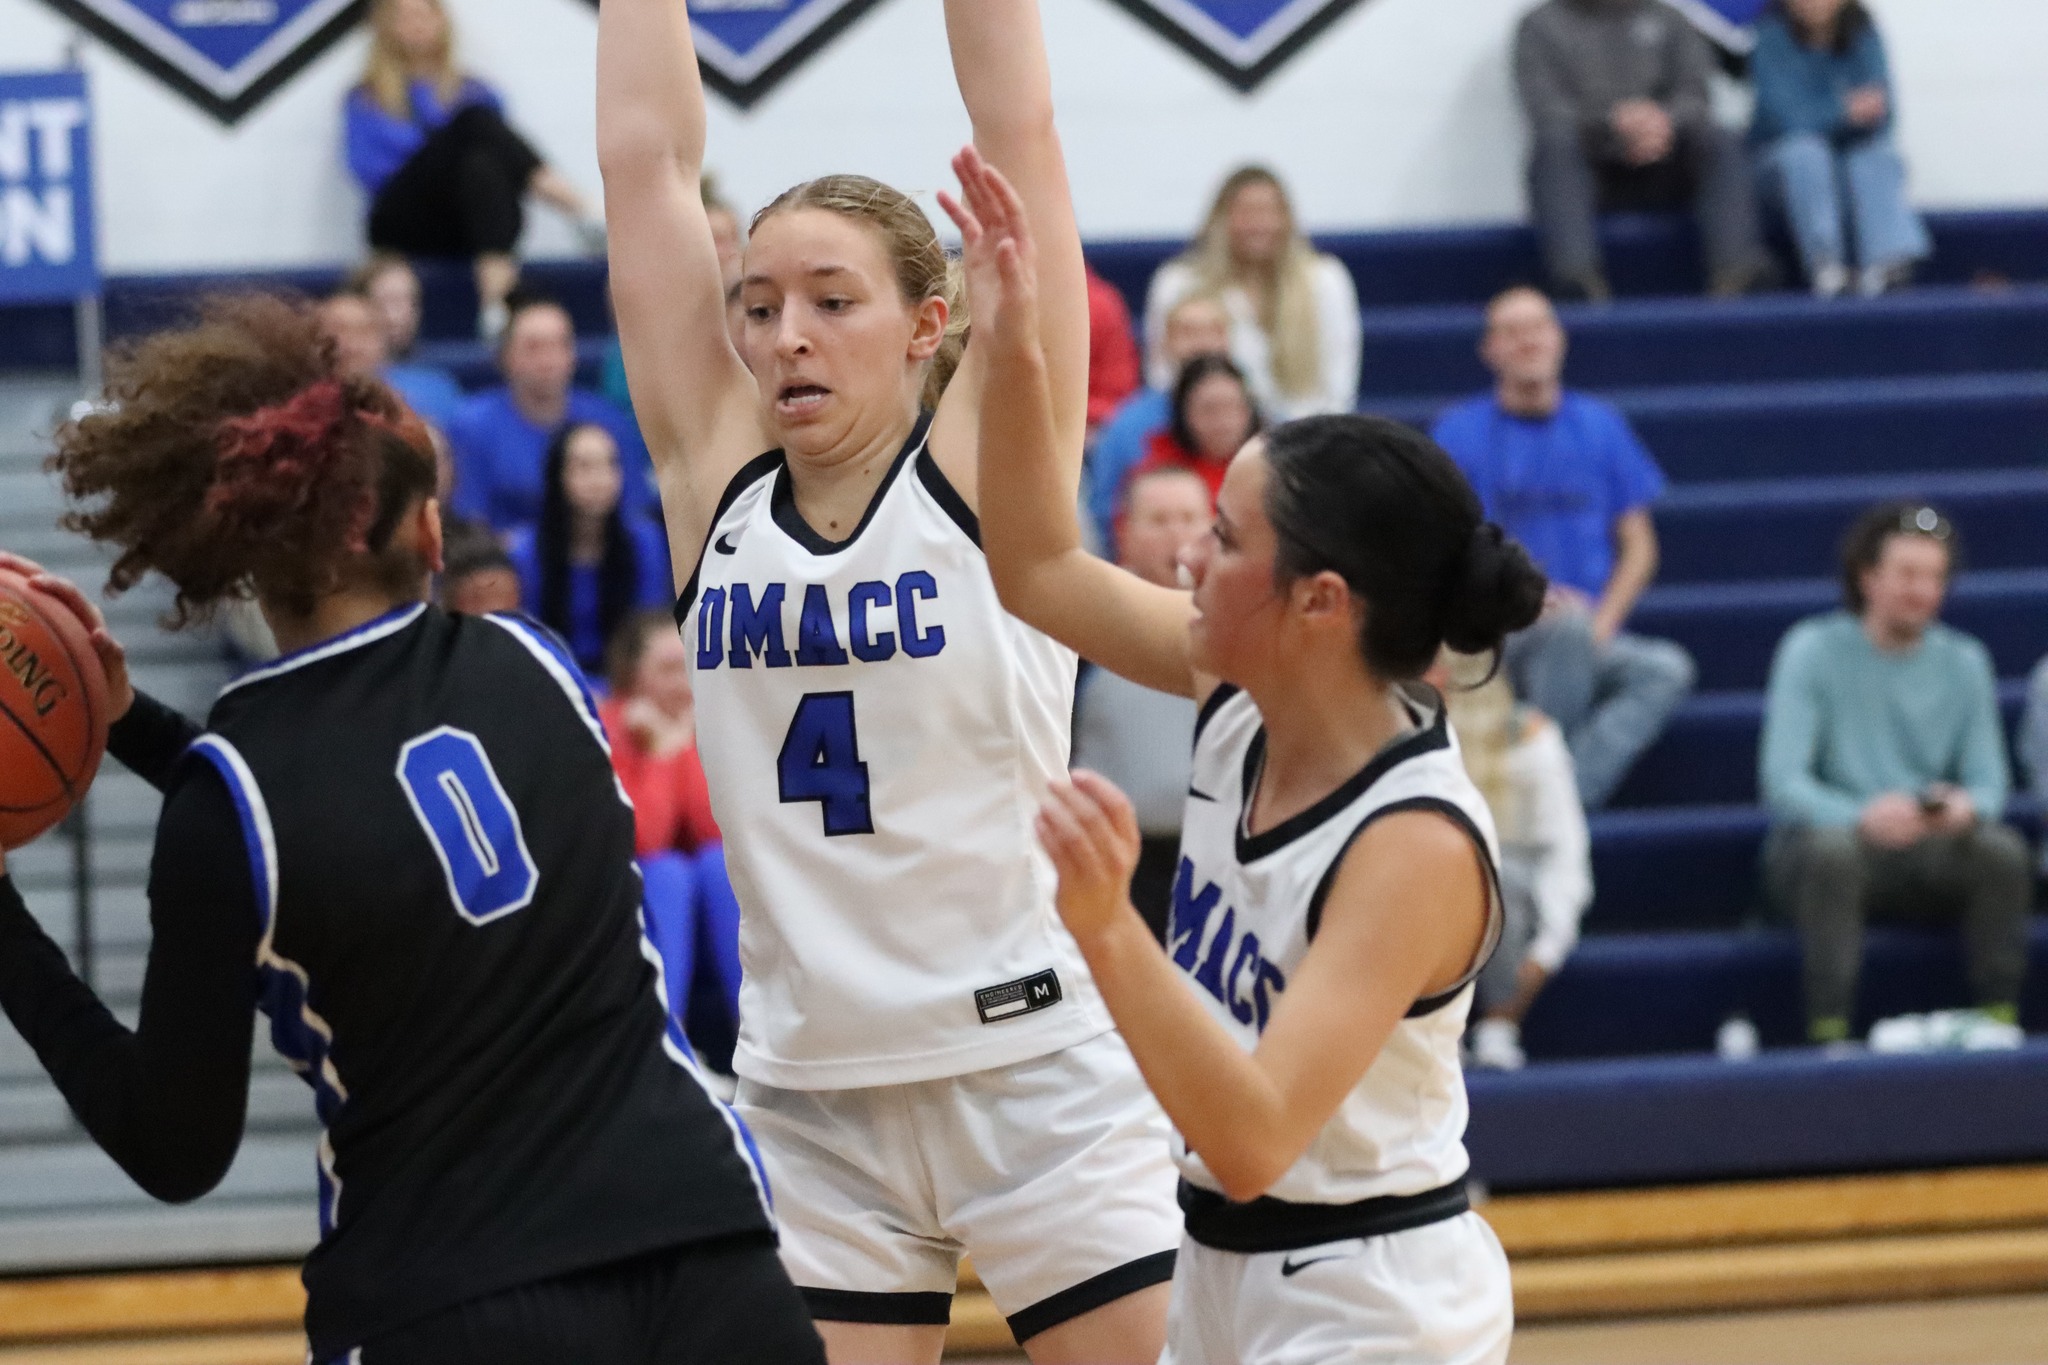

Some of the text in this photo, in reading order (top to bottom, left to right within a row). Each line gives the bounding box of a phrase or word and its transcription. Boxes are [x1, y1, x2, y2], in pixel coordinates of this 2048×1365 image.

[697, 570, 946, 670] DMACC
[777, 690, 875, 837] 4
[395, 724, 540, 927] 0
[1033, 983, 1050, 999] M
